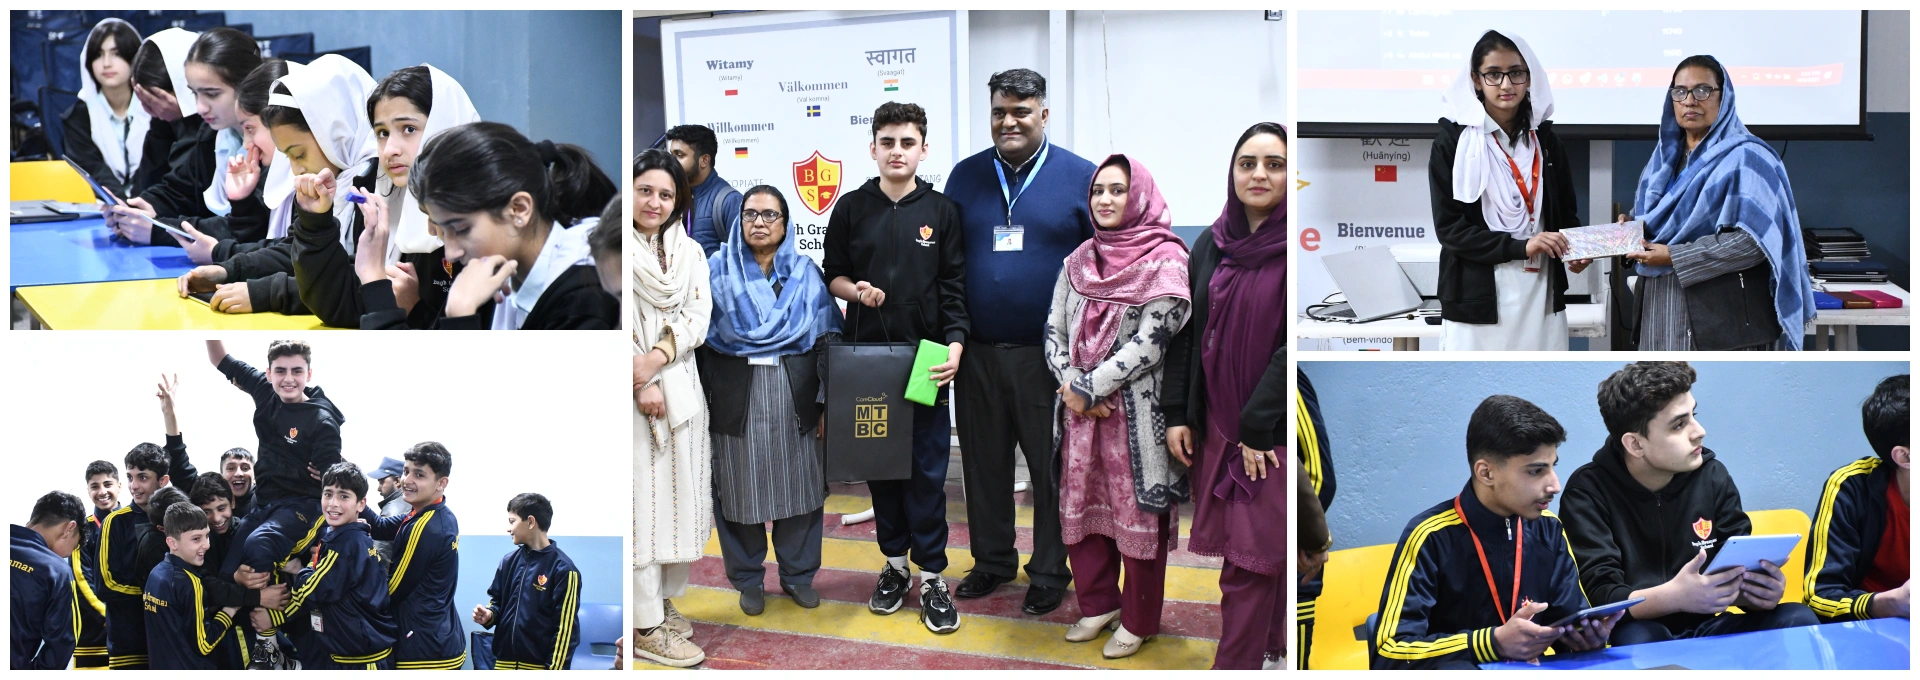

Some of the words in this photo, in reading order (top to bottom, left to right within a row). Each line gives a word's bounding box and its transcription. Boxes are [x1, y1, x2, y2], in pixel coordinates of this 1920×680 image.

[865, 48, 917, 66] स्वागत
[706, 60, 754, 70] Witamy
[718, 74, 743, 82] (Witamy)
[878, 68, 905, 77] (Svaagat)
[778, 81, 848, 93] Välkommen
[1363, 151, 1411, 162] (Huānying)
[804, 169, 815, 182] B
[820, 169, 831, 181] G
[807, 189, 815, 201] S
[1338, 222, 1425, 238] Bienvenue
